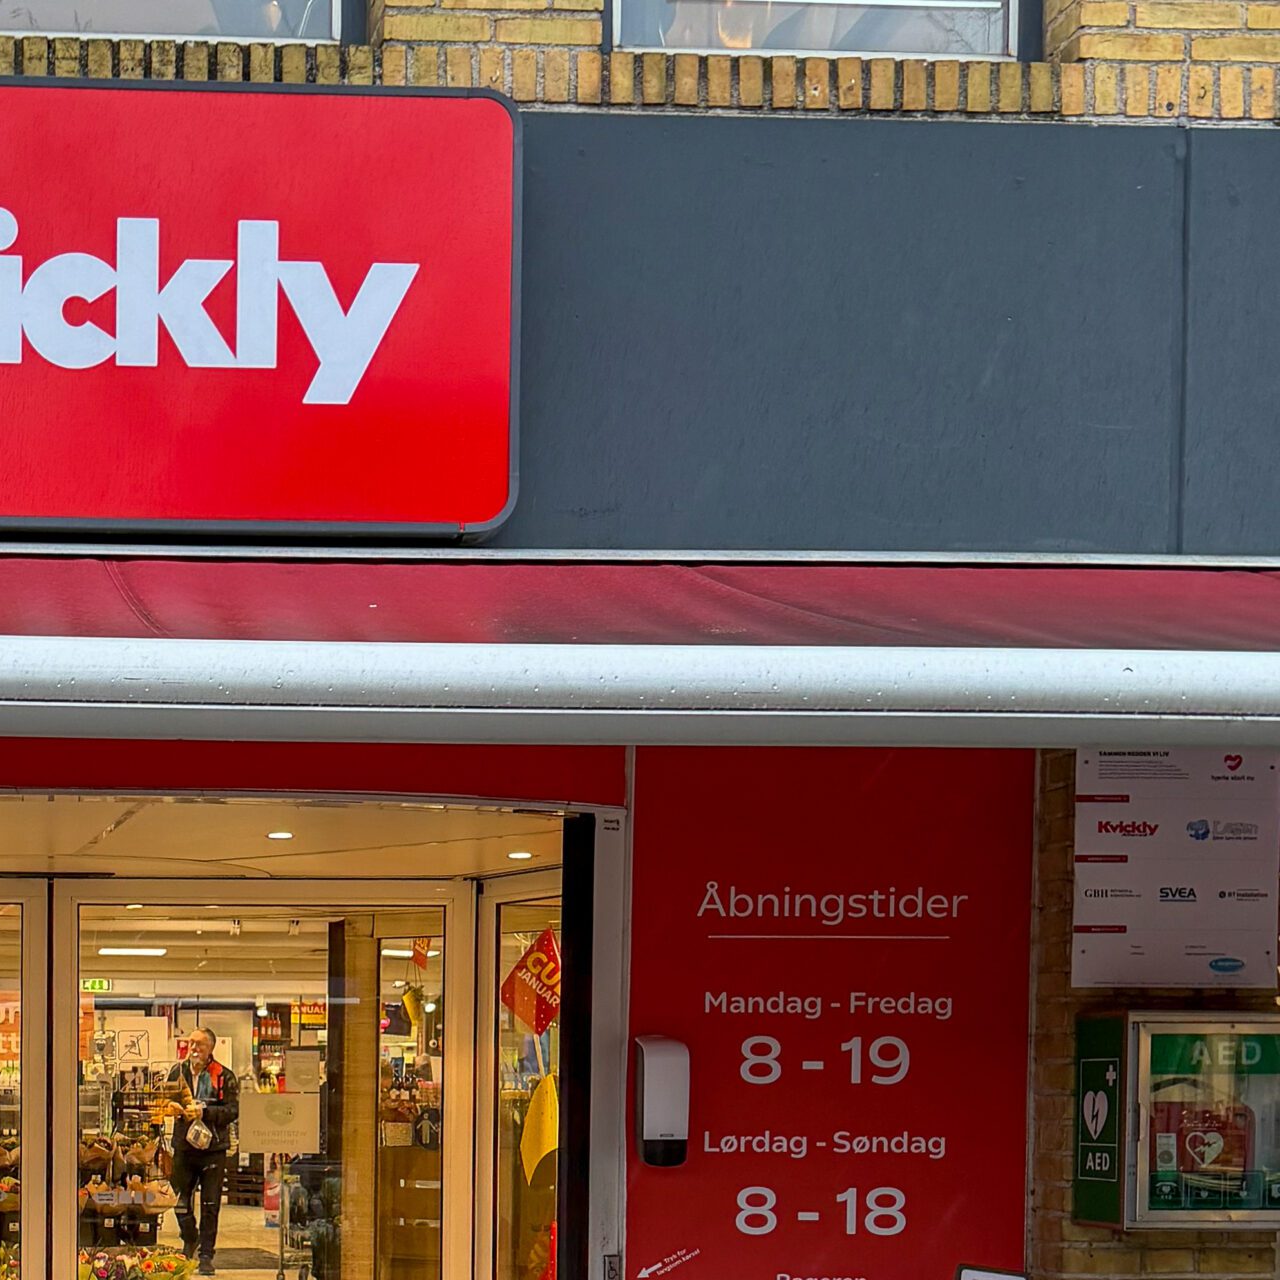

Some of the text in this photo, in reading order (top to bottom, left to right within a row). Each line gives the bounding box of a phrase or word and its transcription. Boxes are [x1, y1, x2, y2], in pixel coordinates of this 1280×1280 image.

[1098, 821, 1159, 836] Kvickly
[697, 881, 969, 926] Åbningstider
[1159, 887, 1196, 898] SVEA
[517, 967, 560, 1008] JANUAR
[705, 991, 821, 1020] Mandag
[850, 992, 953, 1020] Fredag
[739, 1035, 910, 1085] 8 - 19
[1190, 1040, 1262, 1066] AED
[704, 1130, 808, 1159] Lørdag
[833, 1131, 947, 1160] Søndag
[1086, 1152, 1110, 1171] AED
[735, 1186, 907, 1236] 8 - 18
